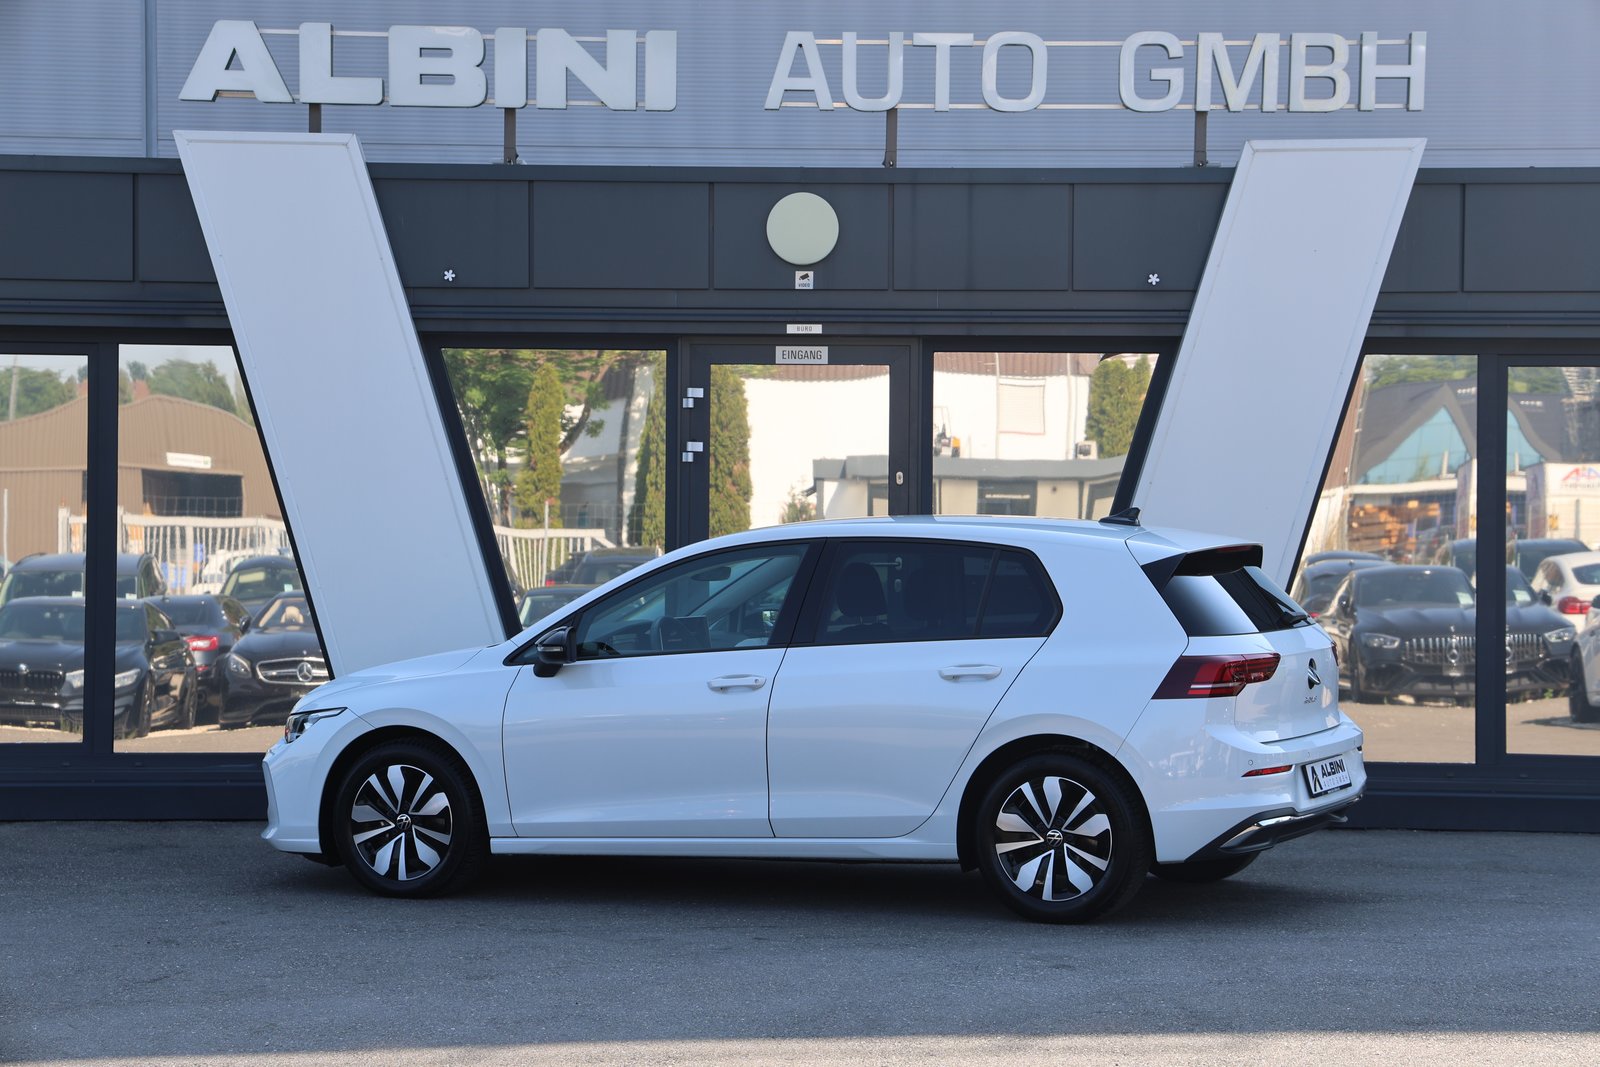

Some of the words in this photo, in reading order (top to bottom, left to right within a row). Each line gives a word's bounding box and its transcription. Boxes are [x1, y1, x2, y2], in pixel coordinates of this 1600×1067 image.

[178, 19, 678, 111] ALBINI
[764, 31, 1048, 112] AUTO
[1118, 30, 1428, 113] GMBH
[782, 349, 822, 360] EINGANG
[1320, 758, 1346, 779] ALBINI
